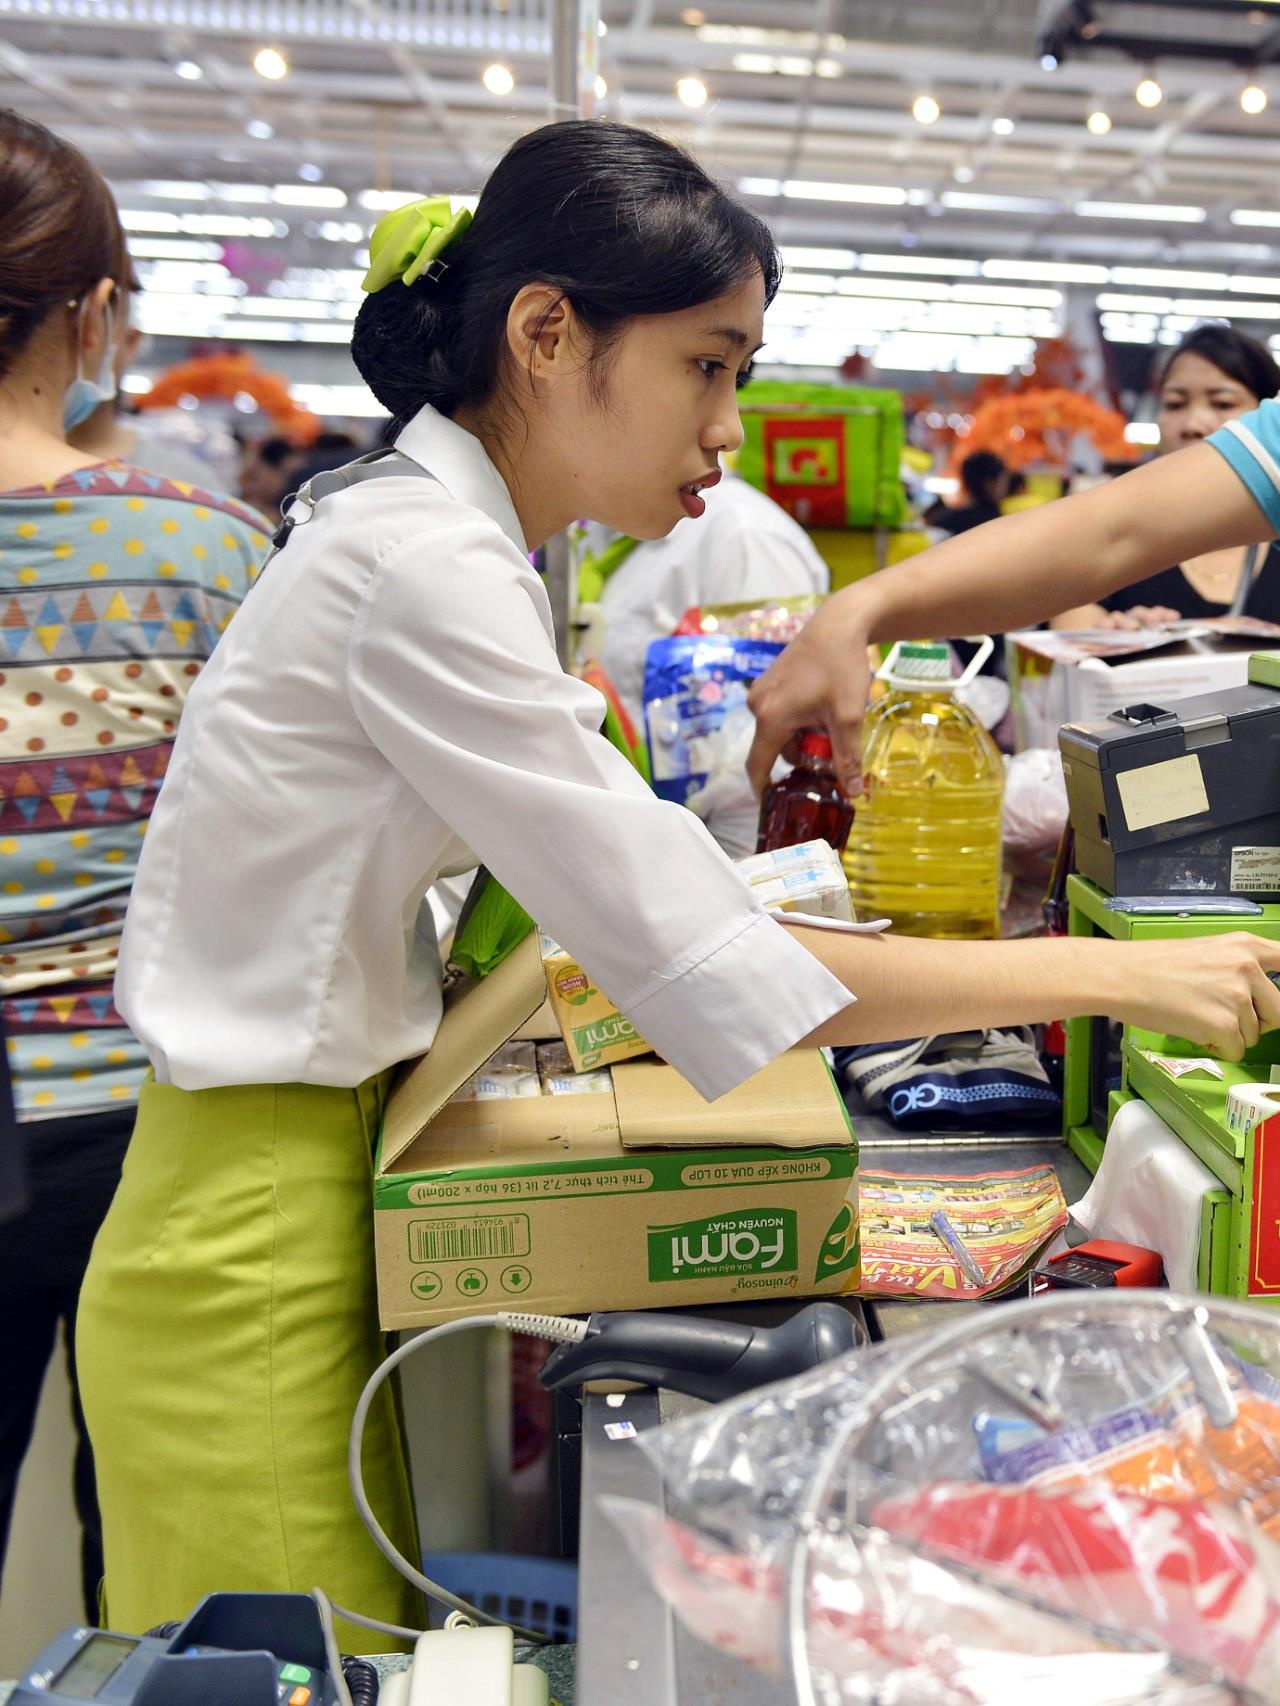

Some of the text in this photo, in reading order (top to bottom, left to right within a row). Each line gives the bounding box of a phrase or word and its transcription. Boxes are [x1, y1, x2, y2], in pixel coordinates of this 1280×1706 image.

[585, 1020, 635, 1048] ami
[714, 1167, 729, 1179] 10
[464, 1185, 471, 1193] x
[475, 1182, 497, 1195] hộp
[502, 1181, 521, 1194] (36
[543, 1178, 561, 1191] 7,2
[596, 1176, 618, 1189] tích
[417, 1186, 460, 1201] 200ml)
[706, 1217, 784, 1234] NGUYÊN CHẤT
